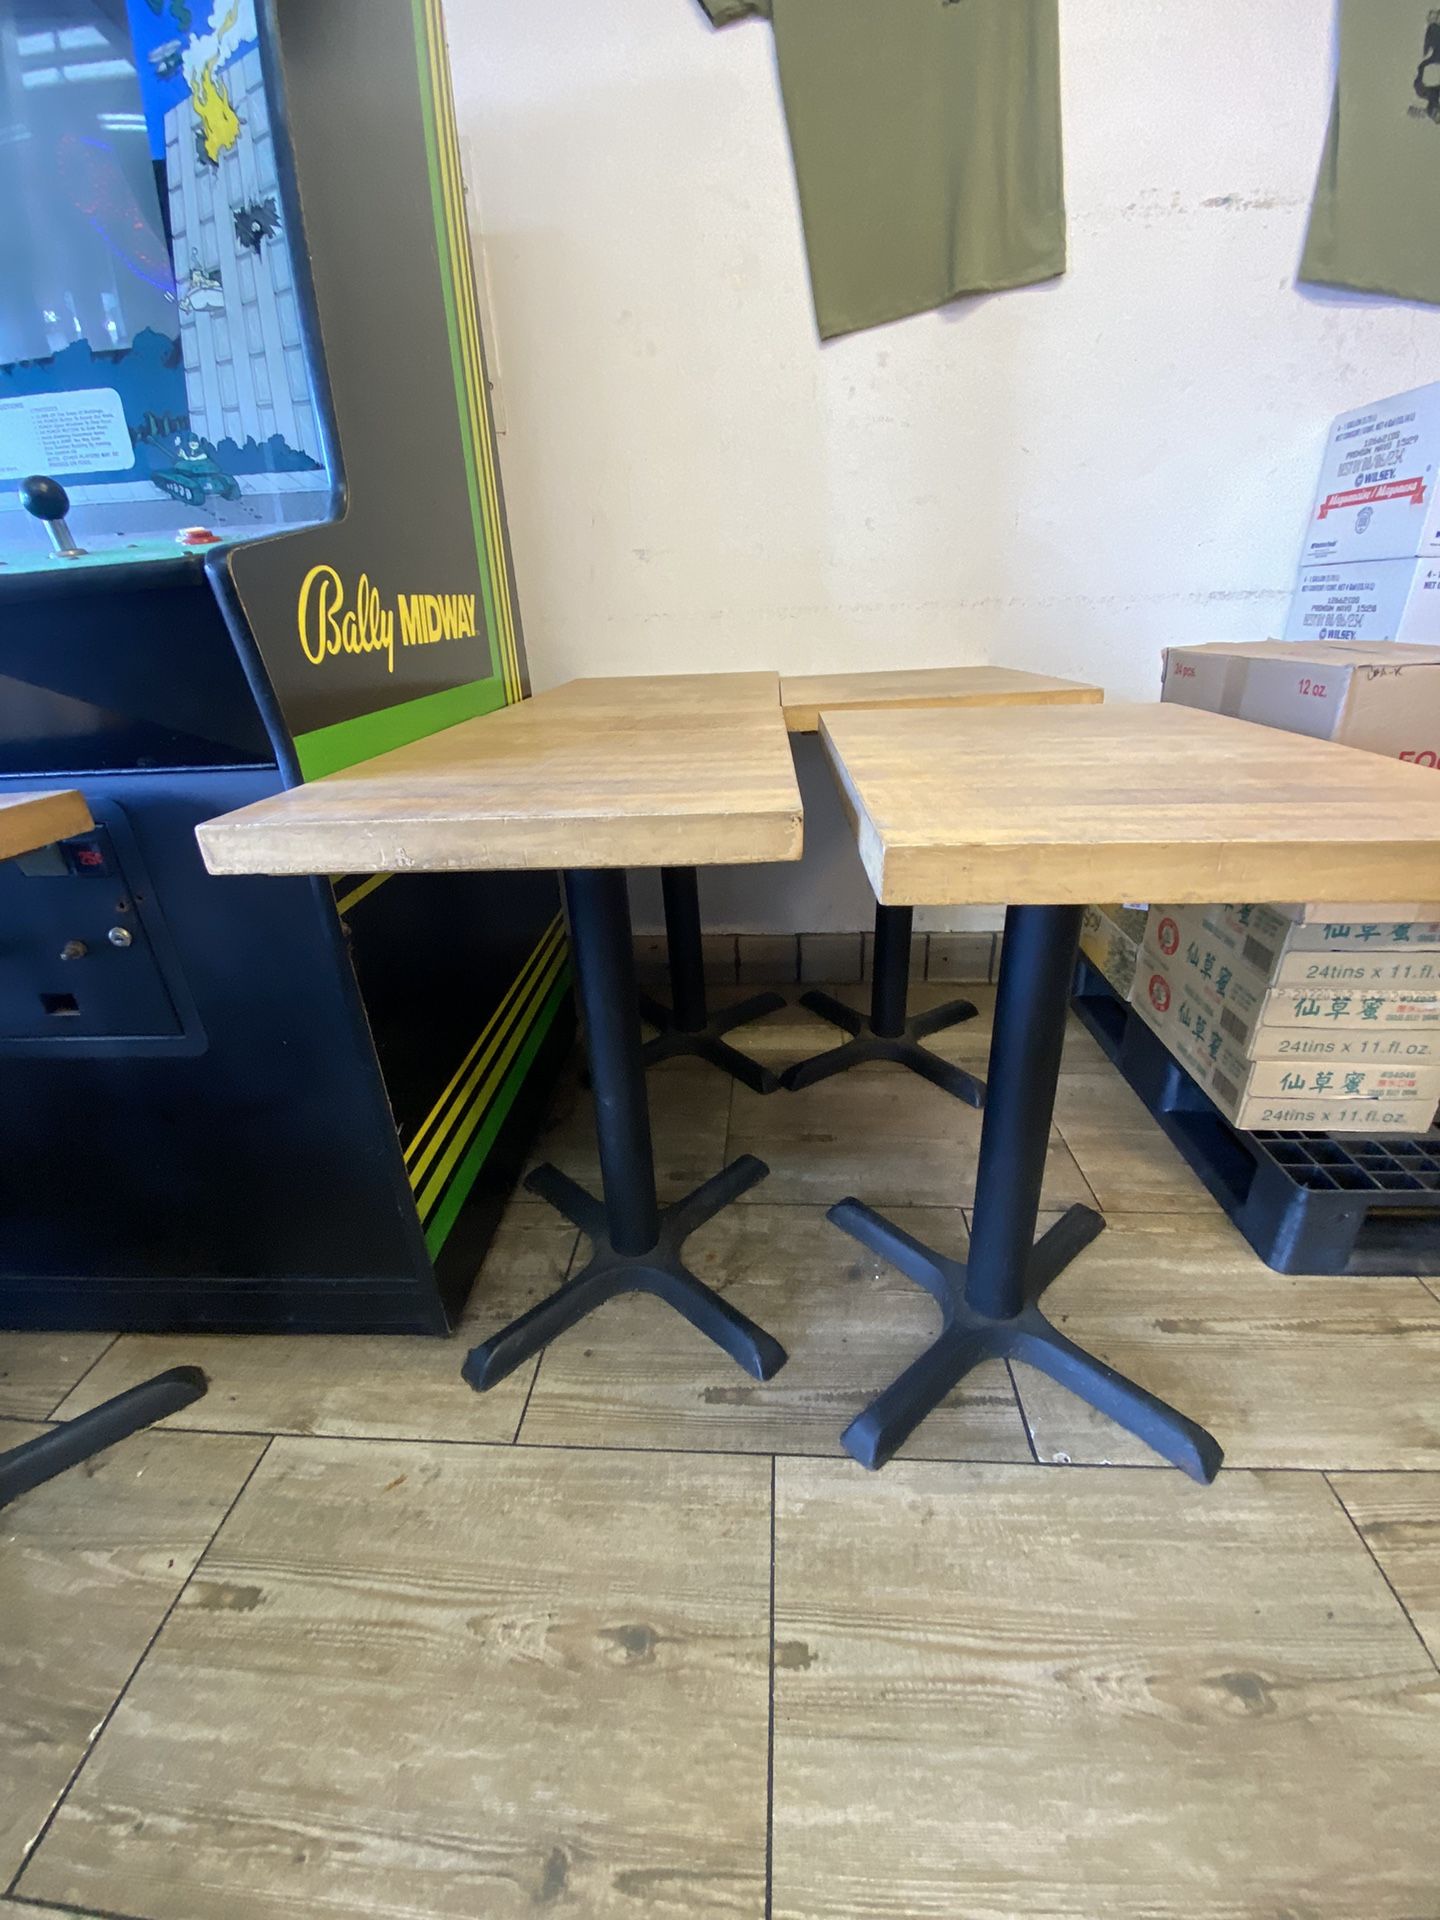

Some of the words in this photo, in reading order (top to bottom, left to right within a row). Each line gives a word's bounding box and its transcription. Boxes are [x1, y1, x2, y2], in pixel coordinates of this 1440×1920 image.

[298, 564, 394, 673] Bally
[397, 594, 476, 646] MIDWAY
[1299, 679, 1310, 696] 12
[1306, 964, 1366, 979] 24tins
[1278, 1039, 1336, 1054] 24tins
[1279, 1071, 1366, 1095] 仙草蜜
[1261, 1109, 1316, 1122] 24tins
